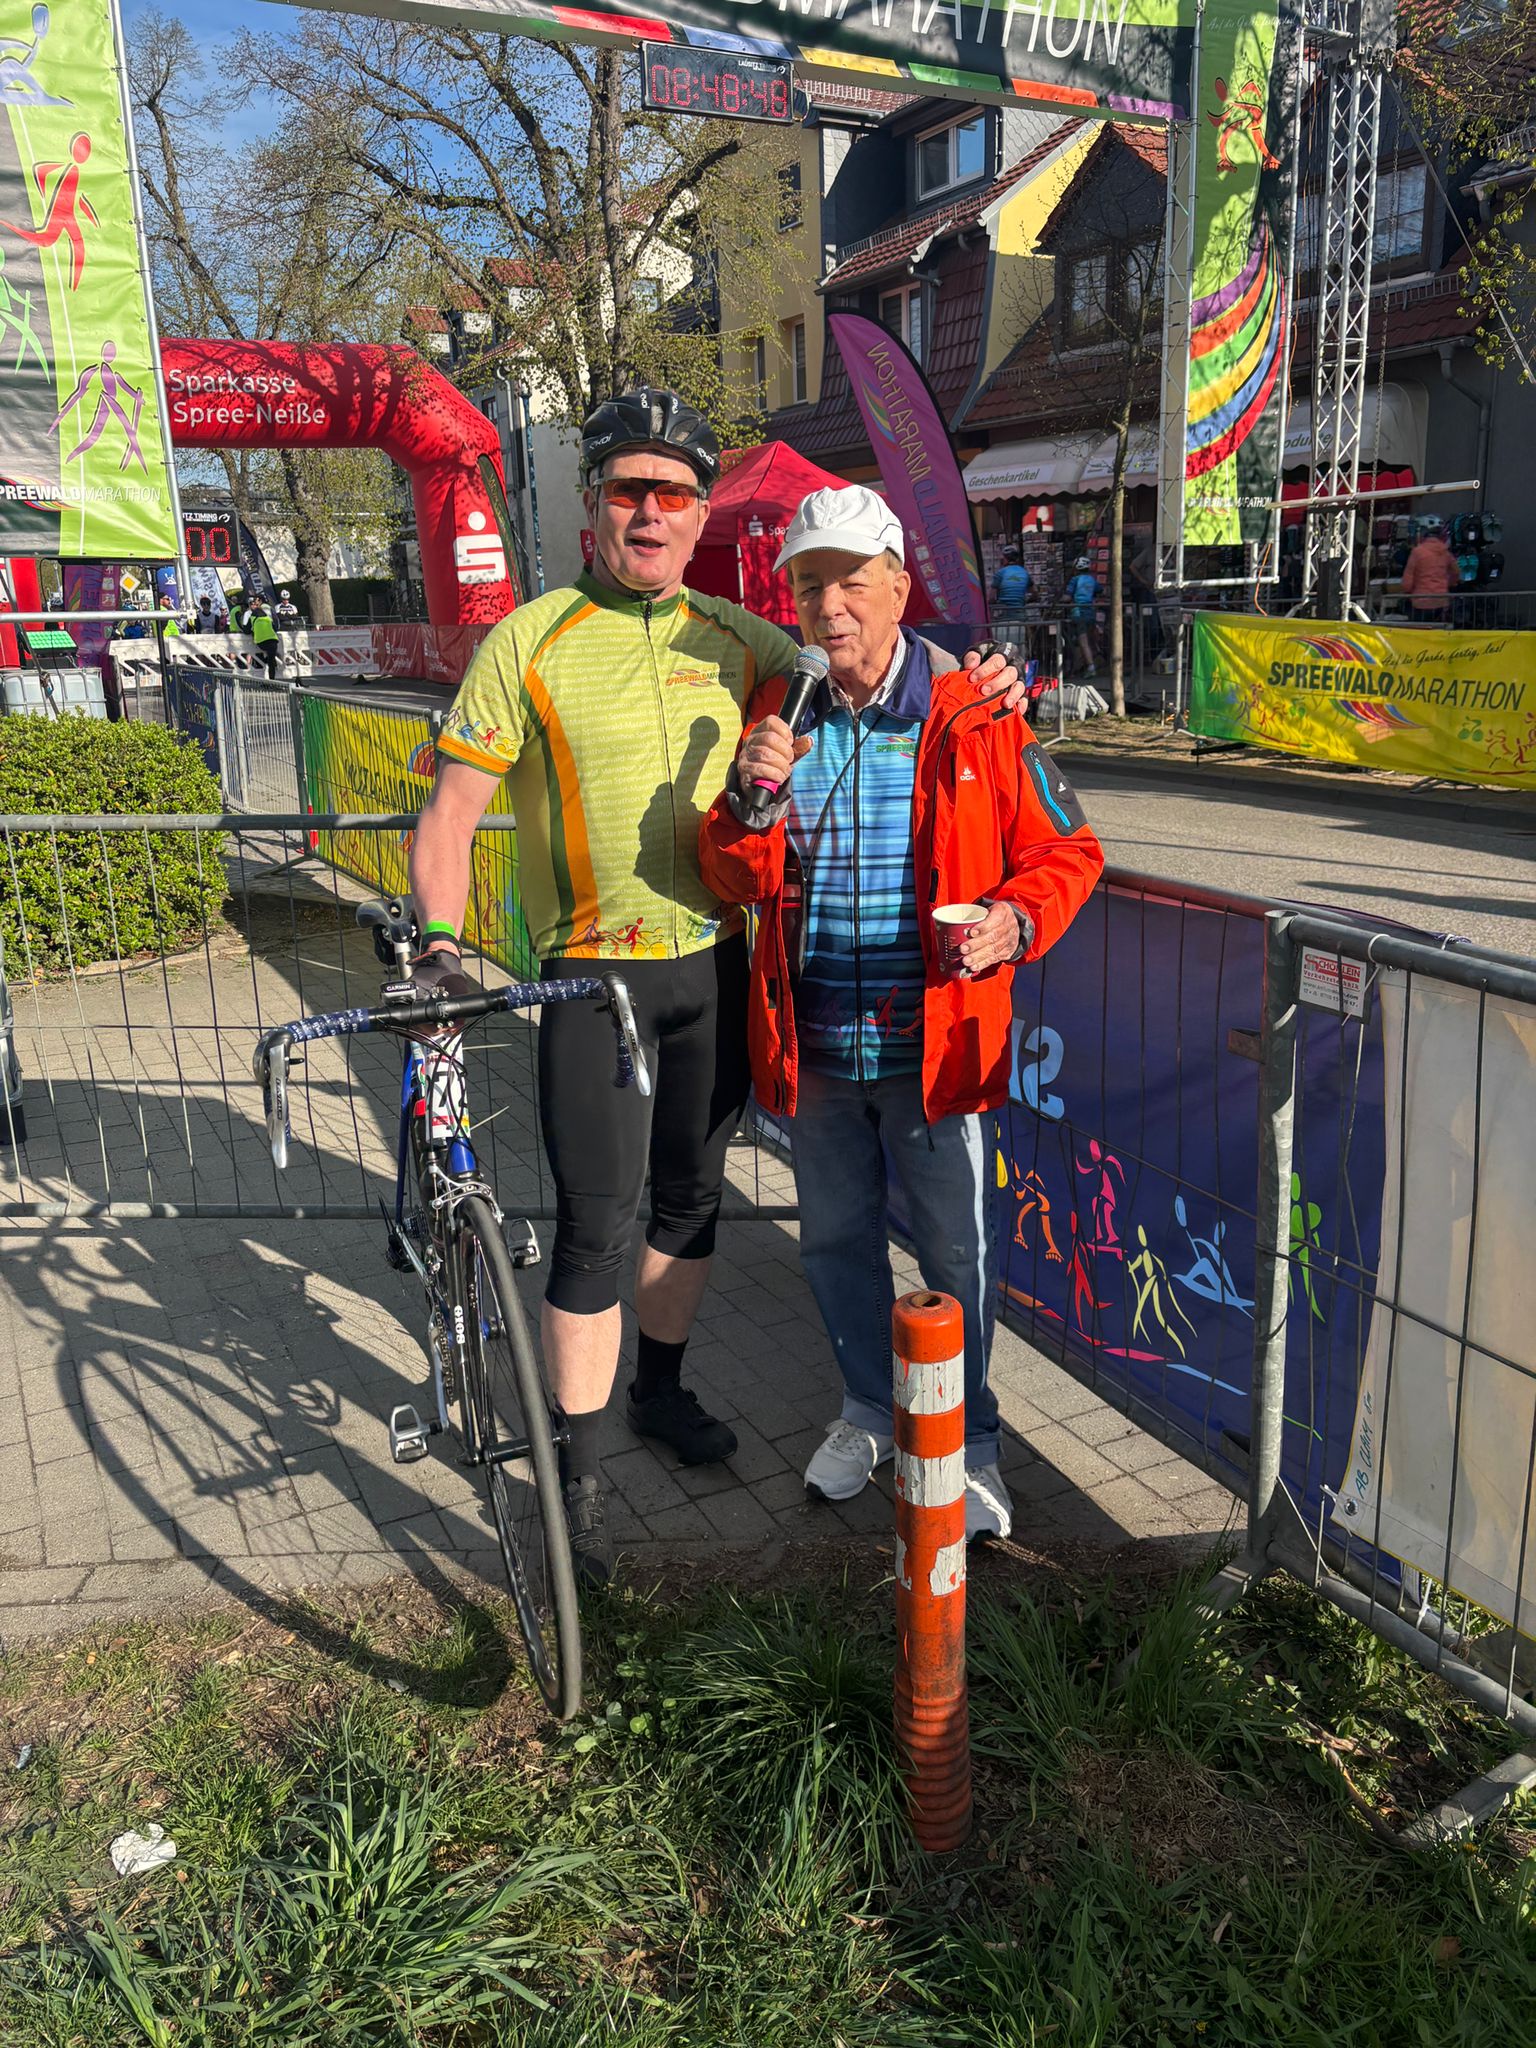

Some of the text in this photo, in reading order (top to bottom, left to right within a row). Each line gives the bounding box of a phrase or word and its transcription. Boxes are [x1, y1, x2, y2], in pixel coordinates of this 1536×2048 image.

[651, 64, 787, 117] 08:48:48
[168, 369, 296, 398] Sparkasse
[173, 401, 326, 428] Spree-Neiße
[968, 467, 1040, 488] Geschenkartikel
[454, 1305, 466, 1345] GIOS
